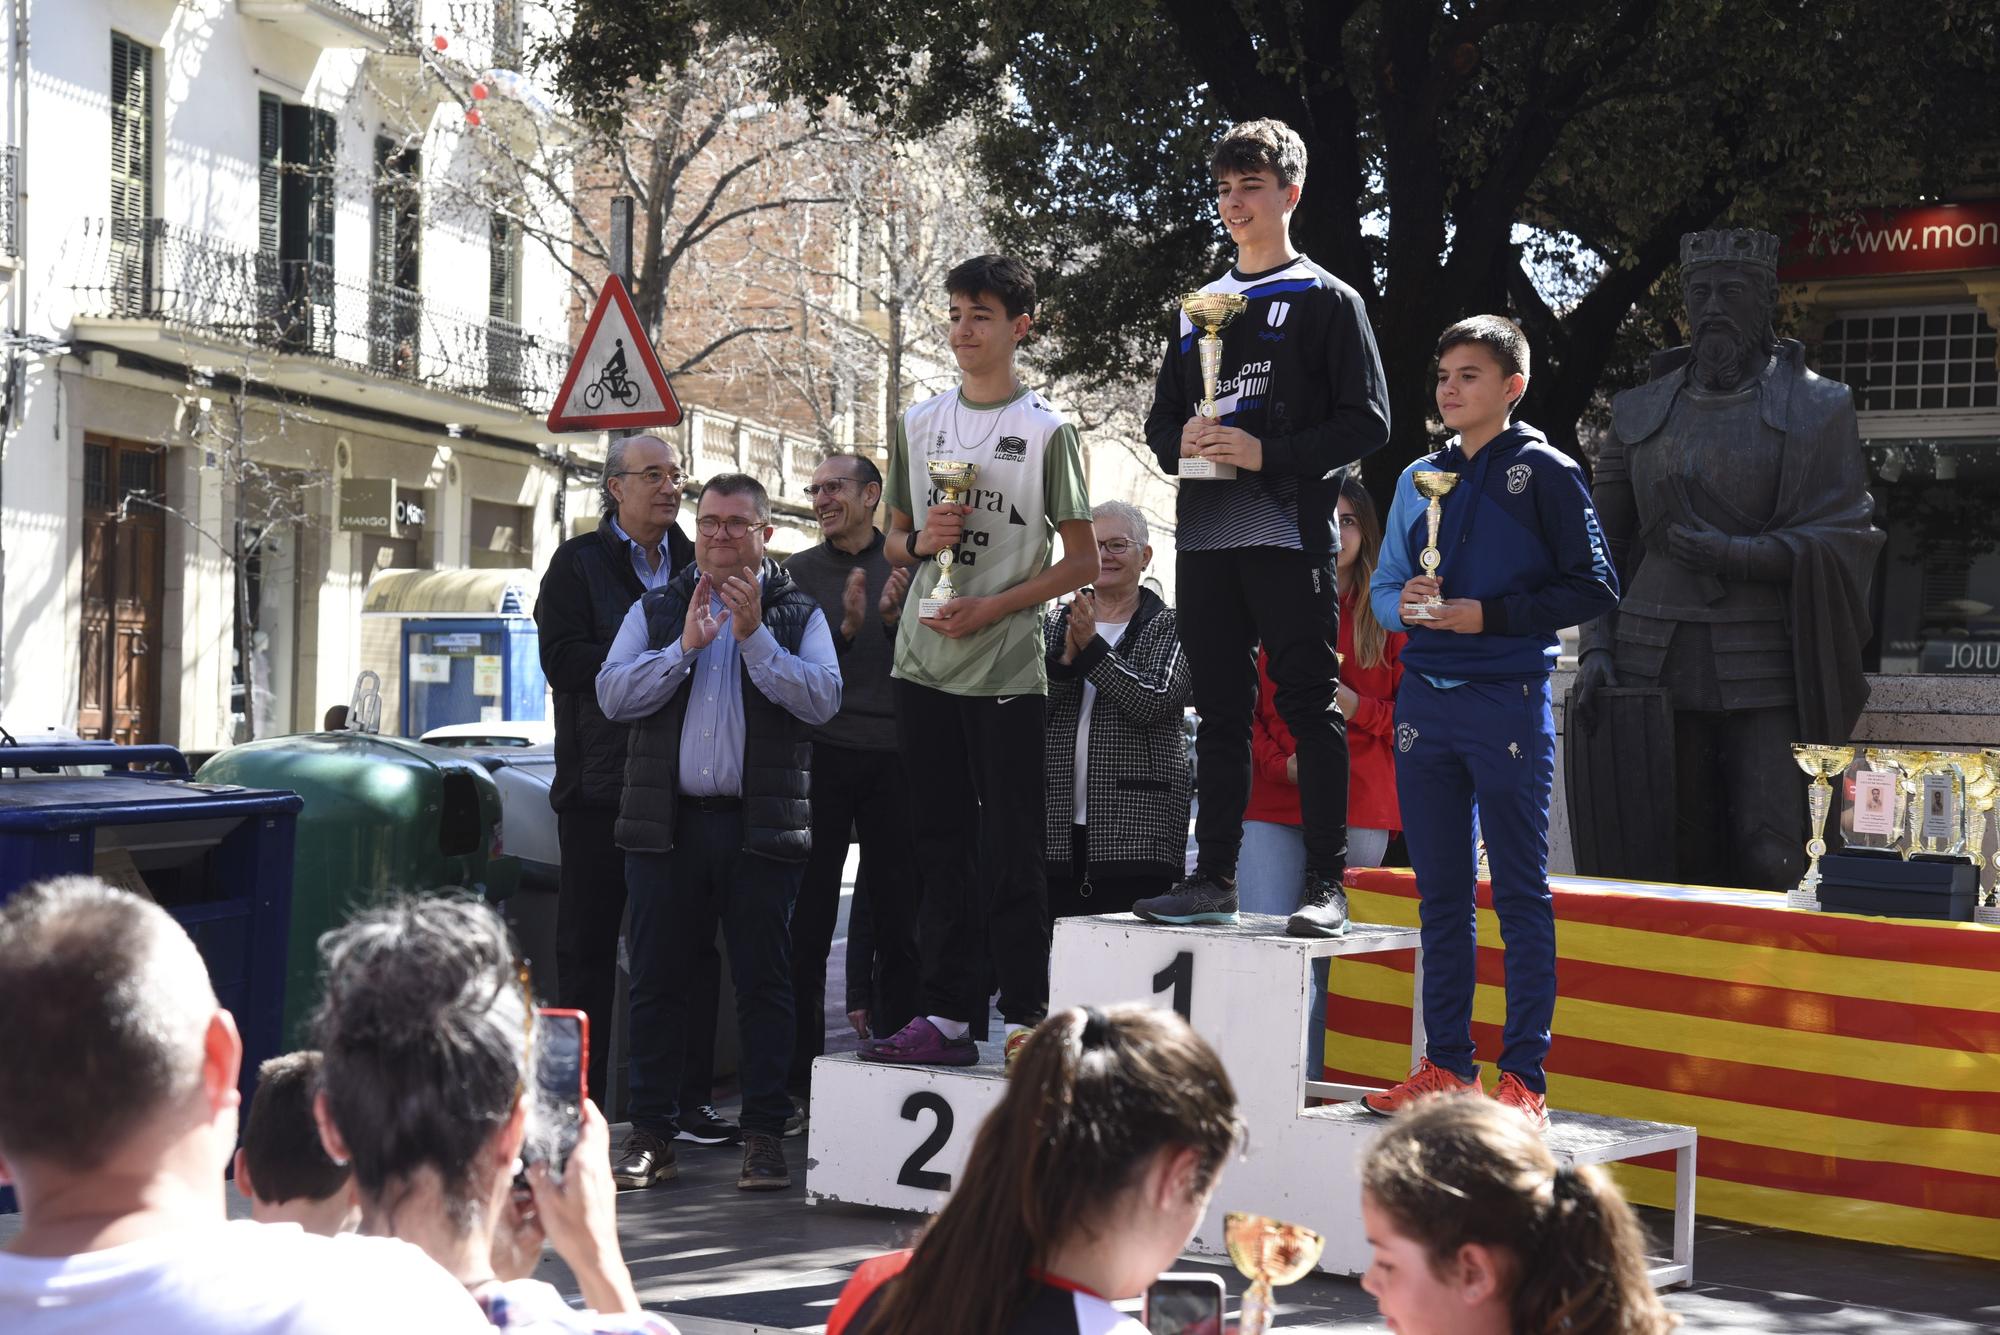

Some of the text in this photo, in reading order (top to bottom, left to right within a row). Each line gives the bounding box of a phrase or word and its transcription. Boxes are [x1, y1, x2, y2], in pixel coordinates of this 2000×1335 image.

[994, 453, 1017, 461] LLEIDA
[343, 517, 388, 527] MANGO
[1584, 508, 1609, 581] LUANVI
[1153, 951, 1194, 1025] 1
[897, 1091, 954, 1192] 2
